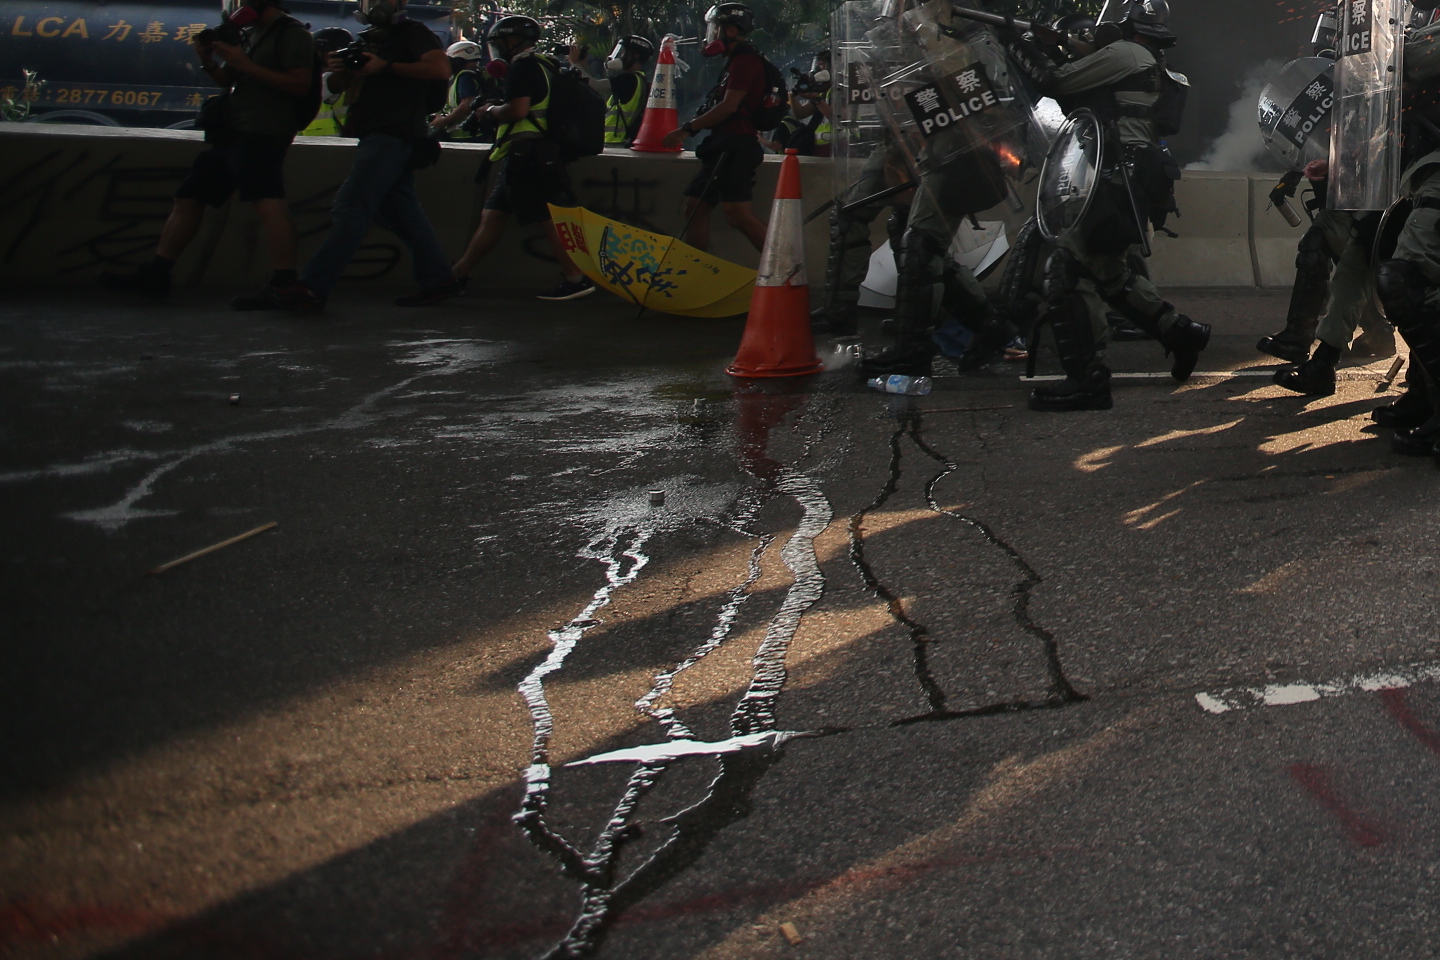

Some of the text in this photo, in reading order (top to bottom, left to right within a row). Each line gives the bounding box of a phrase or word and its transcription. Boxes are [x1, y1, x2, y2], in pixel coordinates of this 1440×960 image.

[11, 16, 89, 39] LCA
[56, 88, 107, 104] 2877
[111, 90, 163, 107] 6067
[914, 69, 982, 113] 警察
[921, 90, 997, 134] POLICE
[1283, 81, 1327, 128] 警察
